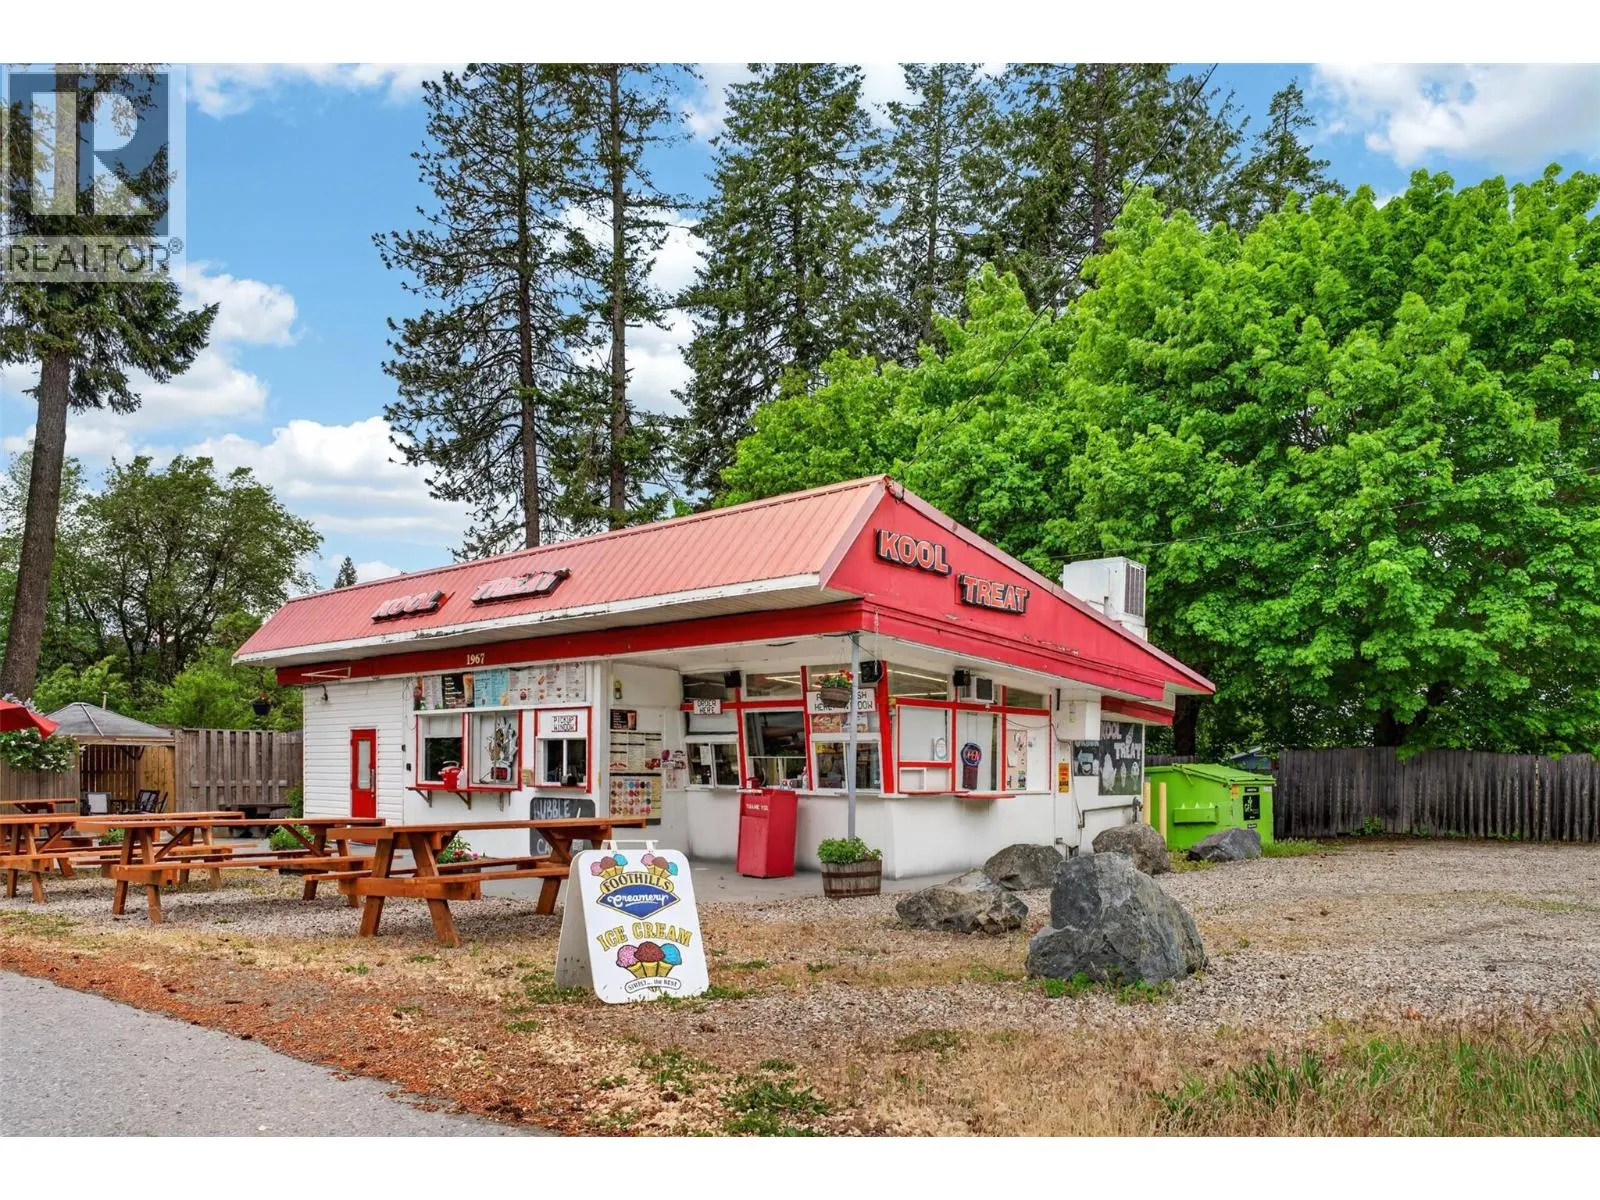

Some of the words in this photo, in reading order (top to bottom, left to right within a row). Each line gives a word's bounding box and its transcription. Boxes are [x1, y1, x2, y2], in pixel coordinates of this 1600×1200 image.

[879, 530, 950, 574] KOOL
[963, 576, 1028, 612] TREAT
[466, 653, 485, 666] 1967
[603, 873, 671, 892] FOOTHILLS
[607, 893, 669, 908] Creamery
[596, 925, 628, 952] ICE
[632, 921, 693, 947] CREAM
